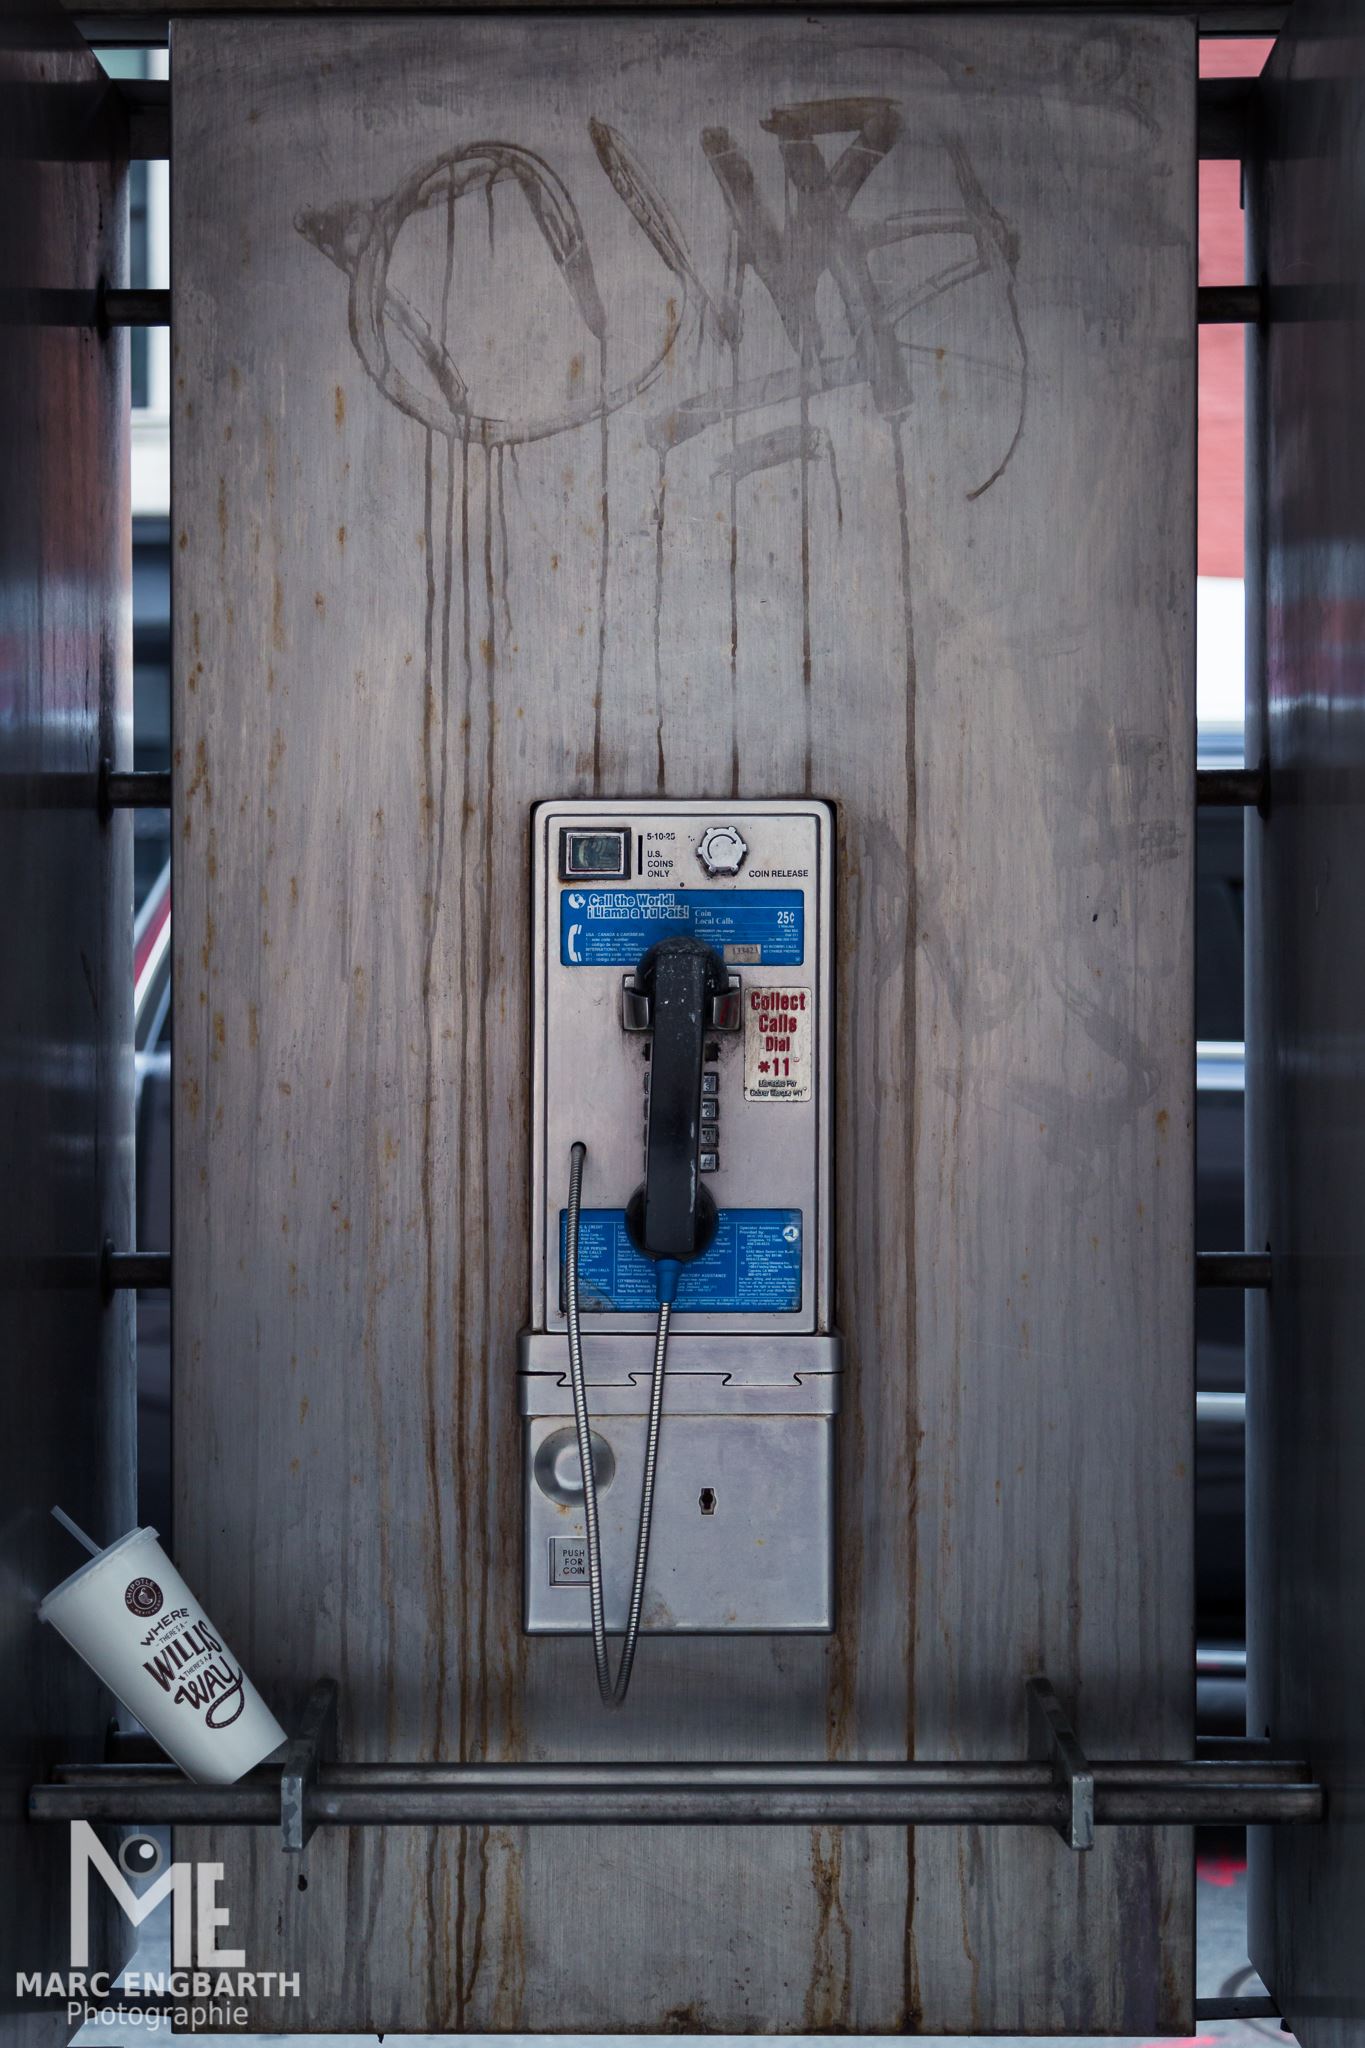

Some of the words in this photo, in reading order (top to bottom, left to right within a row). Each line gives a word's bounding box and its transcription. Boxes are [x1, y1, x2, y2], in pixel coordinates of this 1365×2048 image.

[646, 832, 676, 841] 5-10-25
[748, 870, 770, 878] COIN
[771, 870, 808, 878] RELEASE
[589, 894, 613, 907] Call
[614, 894, 636, 907] the
[636, 894, 675, 907] World!
[630, 908, 640, 919] a
[777, 912, 794, 925] 25¢
[750, 991, 806, 1011] Collect
[758, 1014, 797, 1032] Calls
[765, 1036, 790, 1052] Dial
[126, 1579, 155, 1604] CHIPOTLE
[140, 1608, 189, 1646] WHERE
[159, 1626, 181, 1644] THERE'S
[184, 1660, 204, 1677] THERE'S
[174, 1656, 245, 1728] WAY
